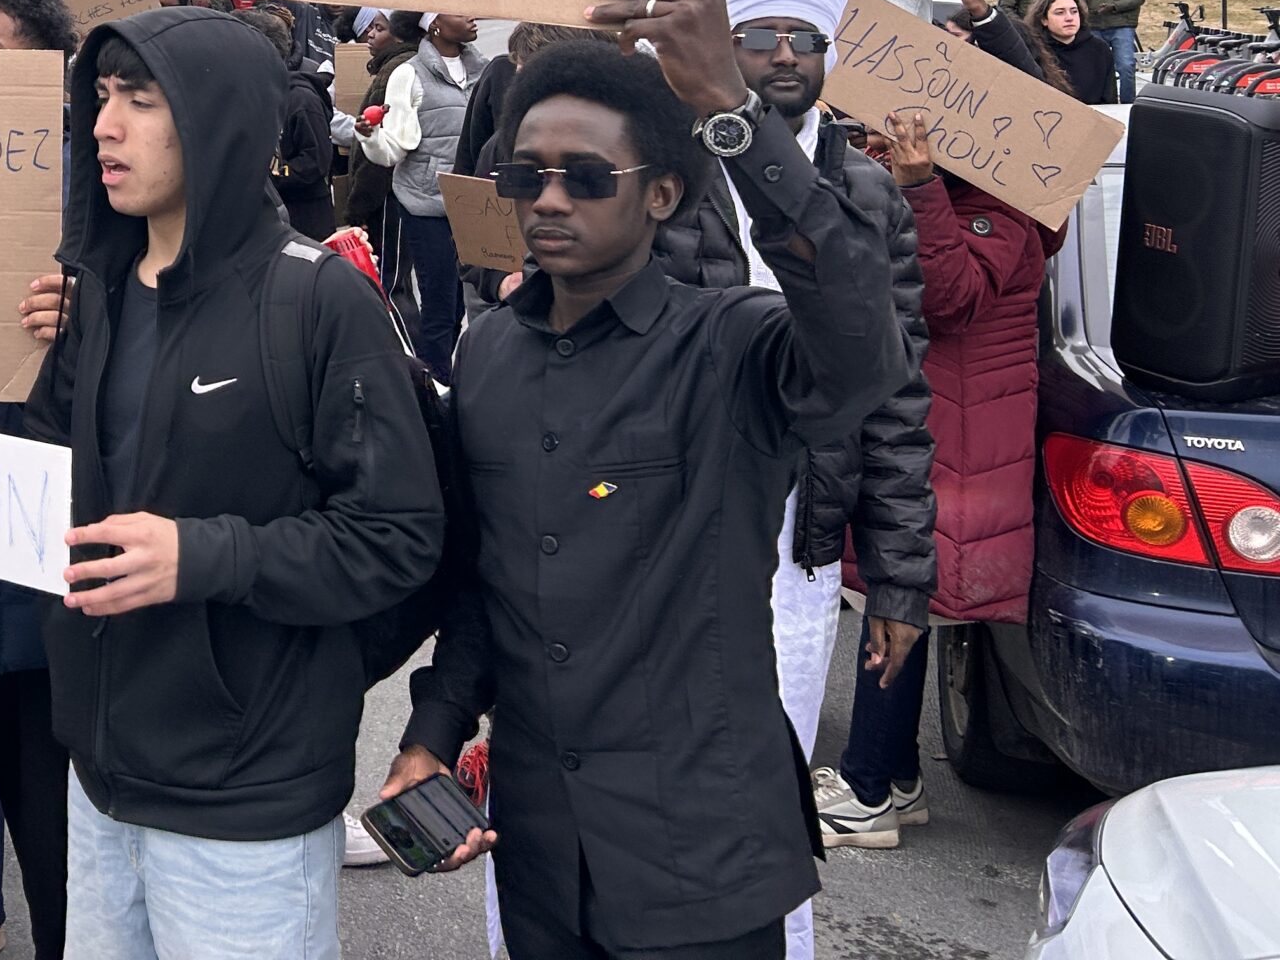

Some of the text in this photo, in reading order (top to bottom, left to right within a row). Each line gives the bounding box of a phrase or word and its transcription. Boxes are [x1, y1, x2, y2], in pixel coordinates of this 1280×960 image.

[835, 8, 988, 119] HASSOUN
[1144, 223, 1177, 254] JBL
[1184, 435, 1244, 451] TOYOTA
